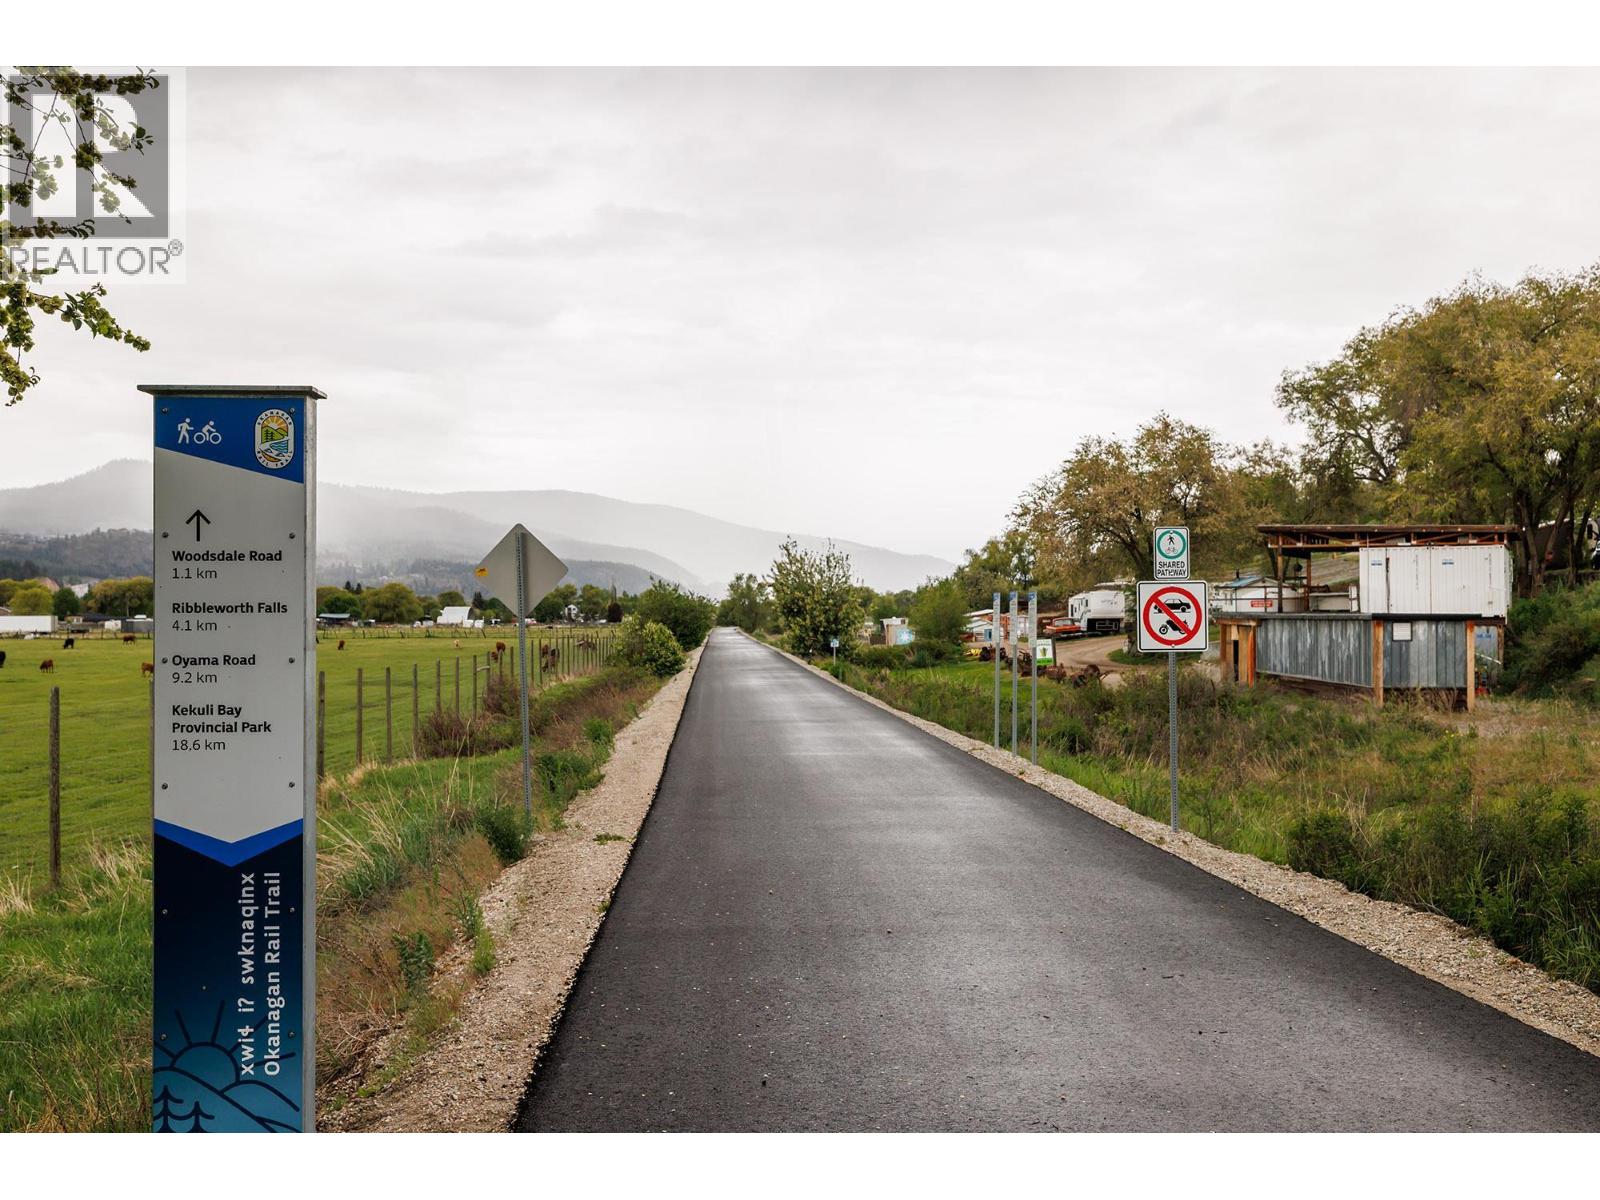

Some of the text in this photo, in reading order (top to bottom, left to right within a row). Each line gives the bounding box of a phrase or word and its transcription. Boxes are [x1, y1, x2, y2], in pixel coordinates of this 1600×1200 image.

[171, 549, 283, 562] Woodsdale Road
[1158, 561, 1186, 569] SHARED
[171, 567, 218, 579] 1.1 km
[1157, 569, 1187, 577] PATHWAY
[171, 601, 288, 614] Ribbleworth Falls
[171, 619, 218, 632] 4.1 km
[171, 653, 256, 669] Oyama Road
[171, 671, 218, 684] 9.2 km
[171, 703, 243, 719] Kekuli Bay
[171, 720, 272, 734] Provincial Park
[171, 738, 226, 751] 18.6 km
[264, 872, 286, 1076] Okanagan Rail Trail
